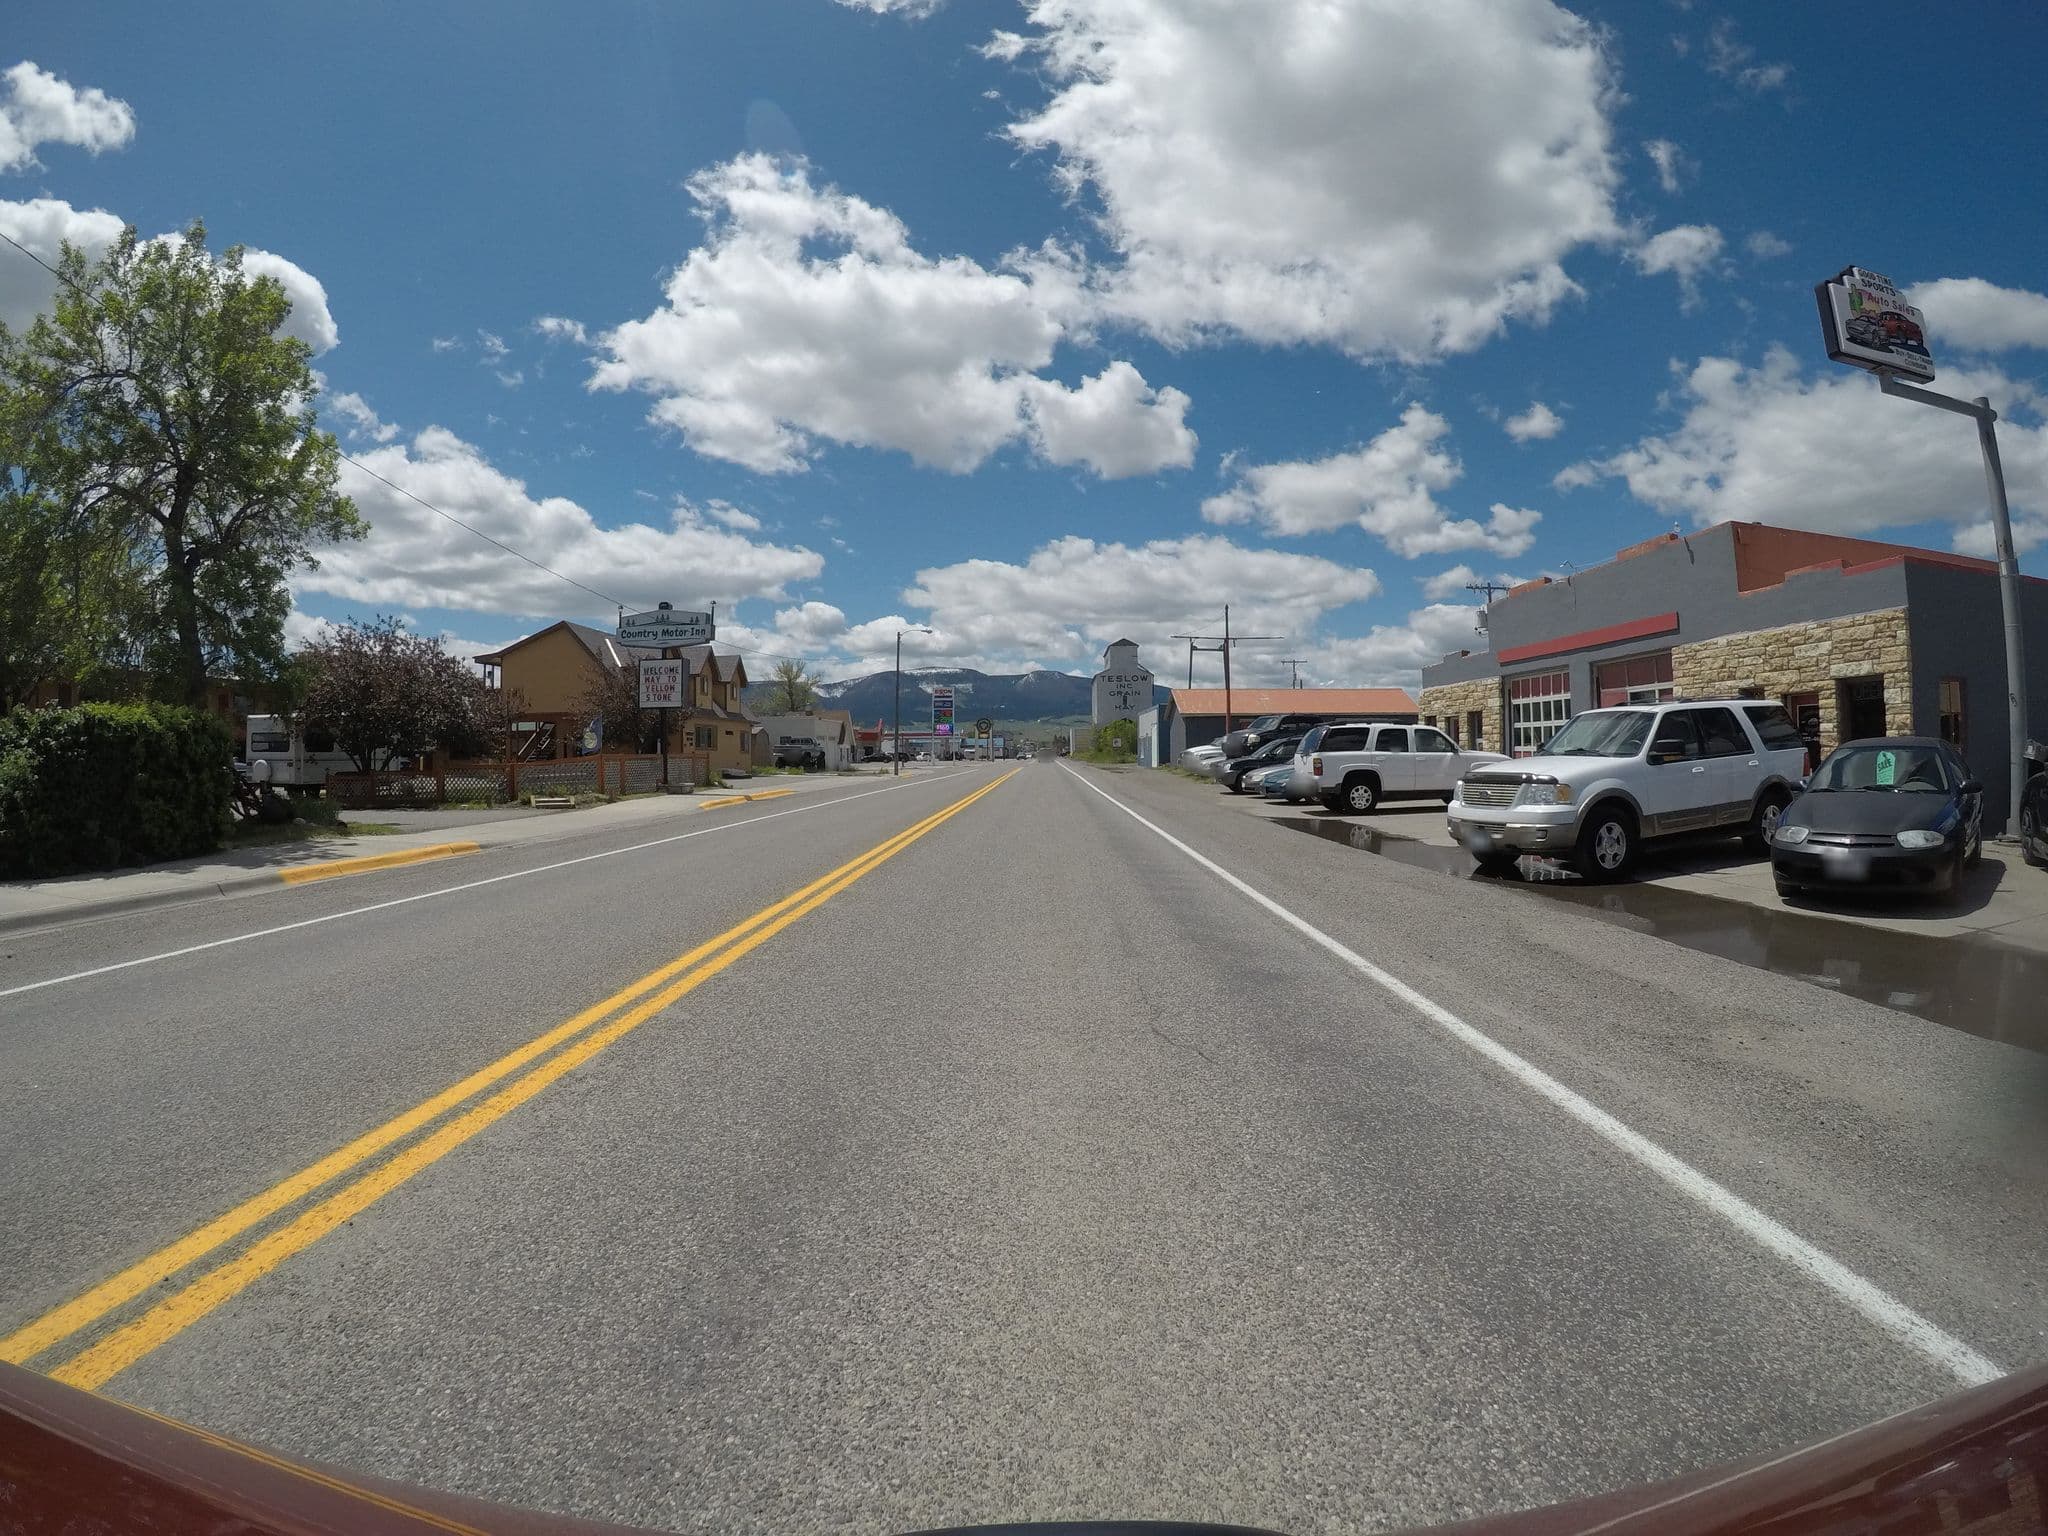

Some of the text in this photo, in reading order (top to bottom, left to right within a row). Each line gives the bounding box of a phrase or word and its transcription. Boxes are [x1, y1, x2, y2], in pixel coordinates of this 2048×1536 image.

[1861, 278, 1896, 297] SPORTS
[1867, 292, 1916, 317] Auto Sales
[621, 627, 706, 640] Country Motor Inn
[644, 665, 679, 675] WELCOME
[668, 675, 677, 683] TO
[1100, 674, 1148, 682] TESLOW
[646, 684, 675, 692] YELLOW
